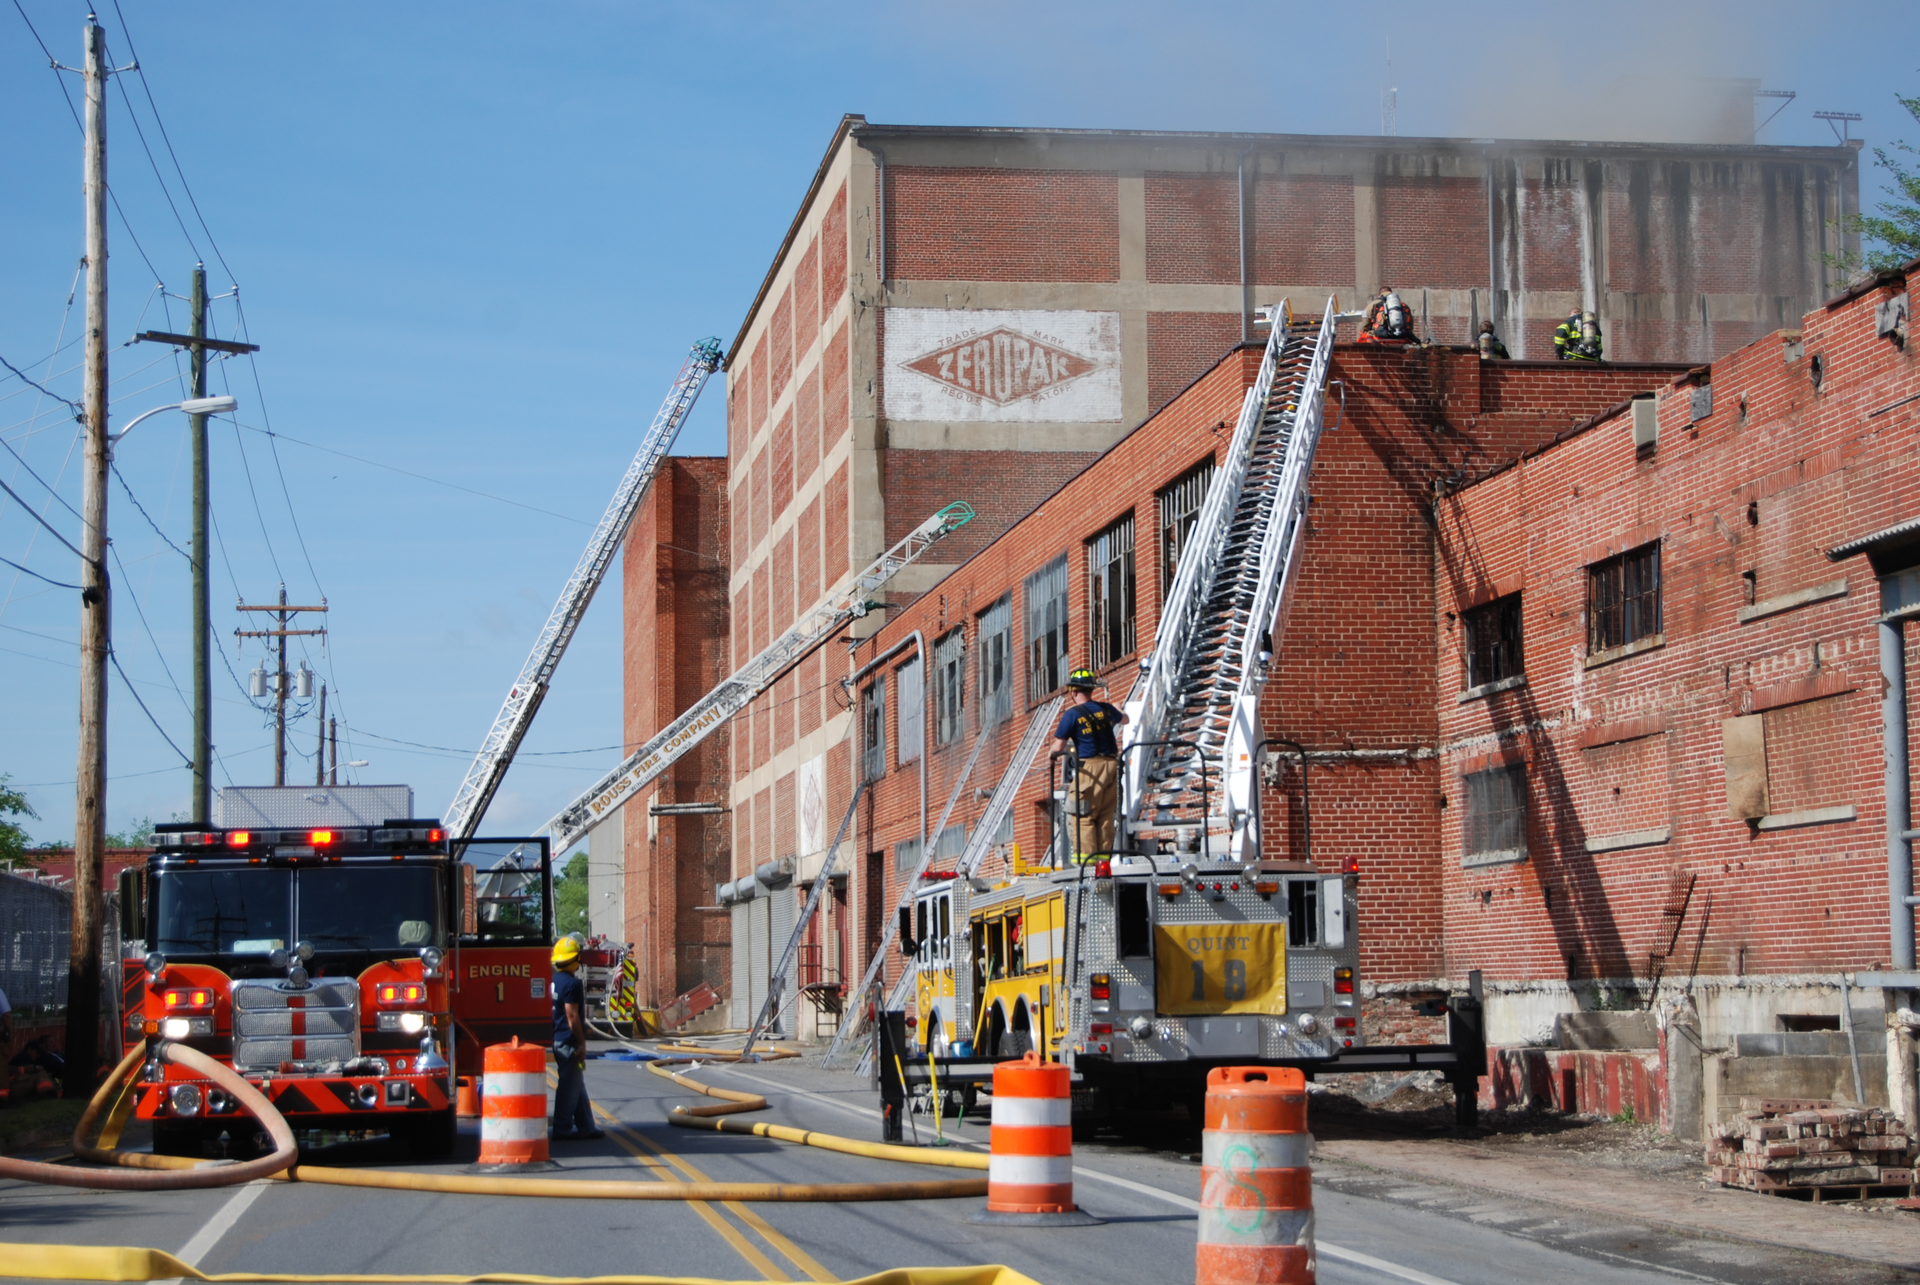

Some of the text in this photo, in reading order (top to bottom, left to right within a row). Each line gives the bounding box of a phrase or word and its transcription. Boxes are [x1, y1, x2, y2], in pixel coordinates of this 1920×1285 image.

[938, 327, 1065, 347] TRADE MARK
[937, 333, 1070, 399] ZEROPAK
[591, 706, 722, 815] ROUSS FIRE COMPANY
[630, 740, 693, 792] WINCHESTER VIRGINIA
[1187, 936, 1250, 951] QUINT
[469, 965, 531, 978] ENGINE
[495, 982, 505, 1002] 1
[1218, 1143, 1266, 1235] S
